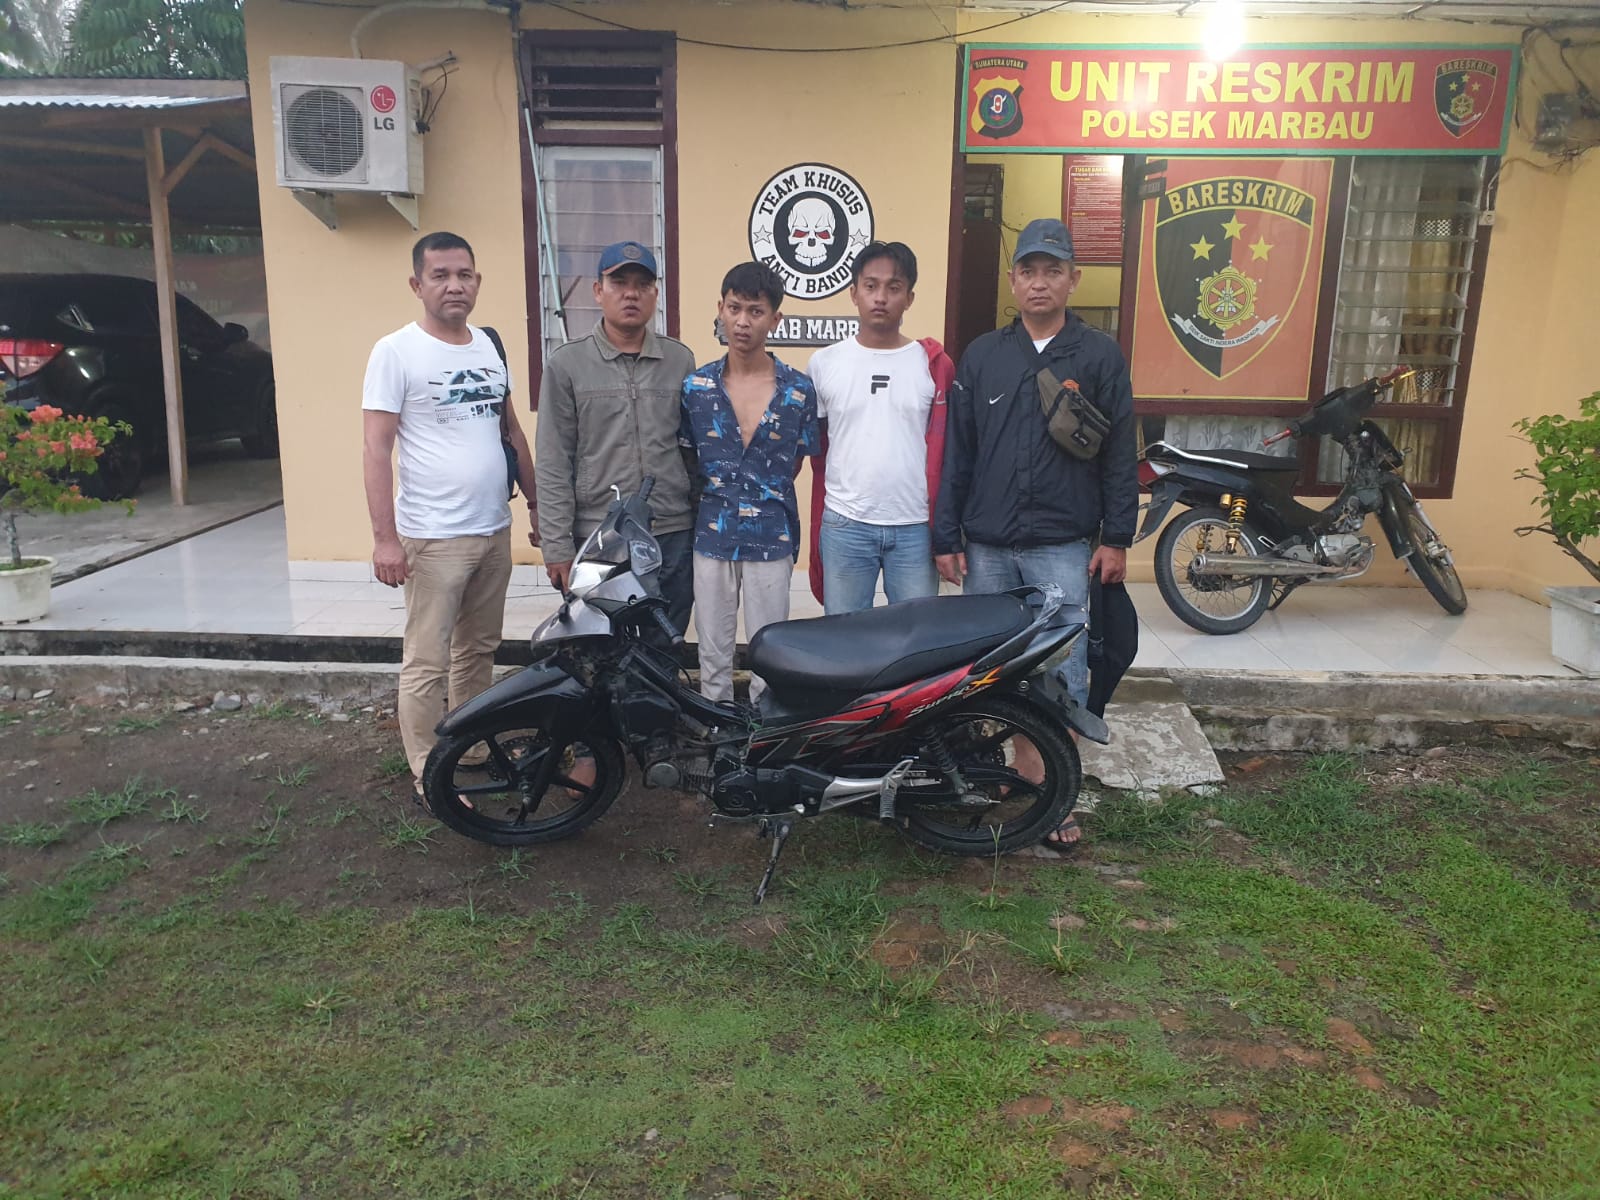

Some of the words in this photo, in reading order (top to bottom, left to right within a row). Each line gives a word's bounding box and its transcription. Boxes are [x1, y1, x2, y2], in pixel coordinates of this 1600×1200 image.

[975, 58, 1005, 69] SUMATERA
[1006, 59, 1024, 69] UTARA
[1440, 60, 1496, 74] BARESKRIM
[1050, 61, 1171, 102] UNIT
[1186, 61, 1416, 103] RESKRIM
[374, 116, 395, 131] LG
[1081, 109, 1217, 140] POLSEK
[1227, 111, 1374, 141] MARBAU
[758, 174, 800, 215] TEAM
[804, 171, 864, 216] KHUSUS
[1167, 182, 1306, 216] BARESKRIM
[761, 254, 801, 291] ANTI
[805, 251, 855, 293] BANDIT
[767, 318, 801, 340] AB
[806, 319, 860, 340] MARB
